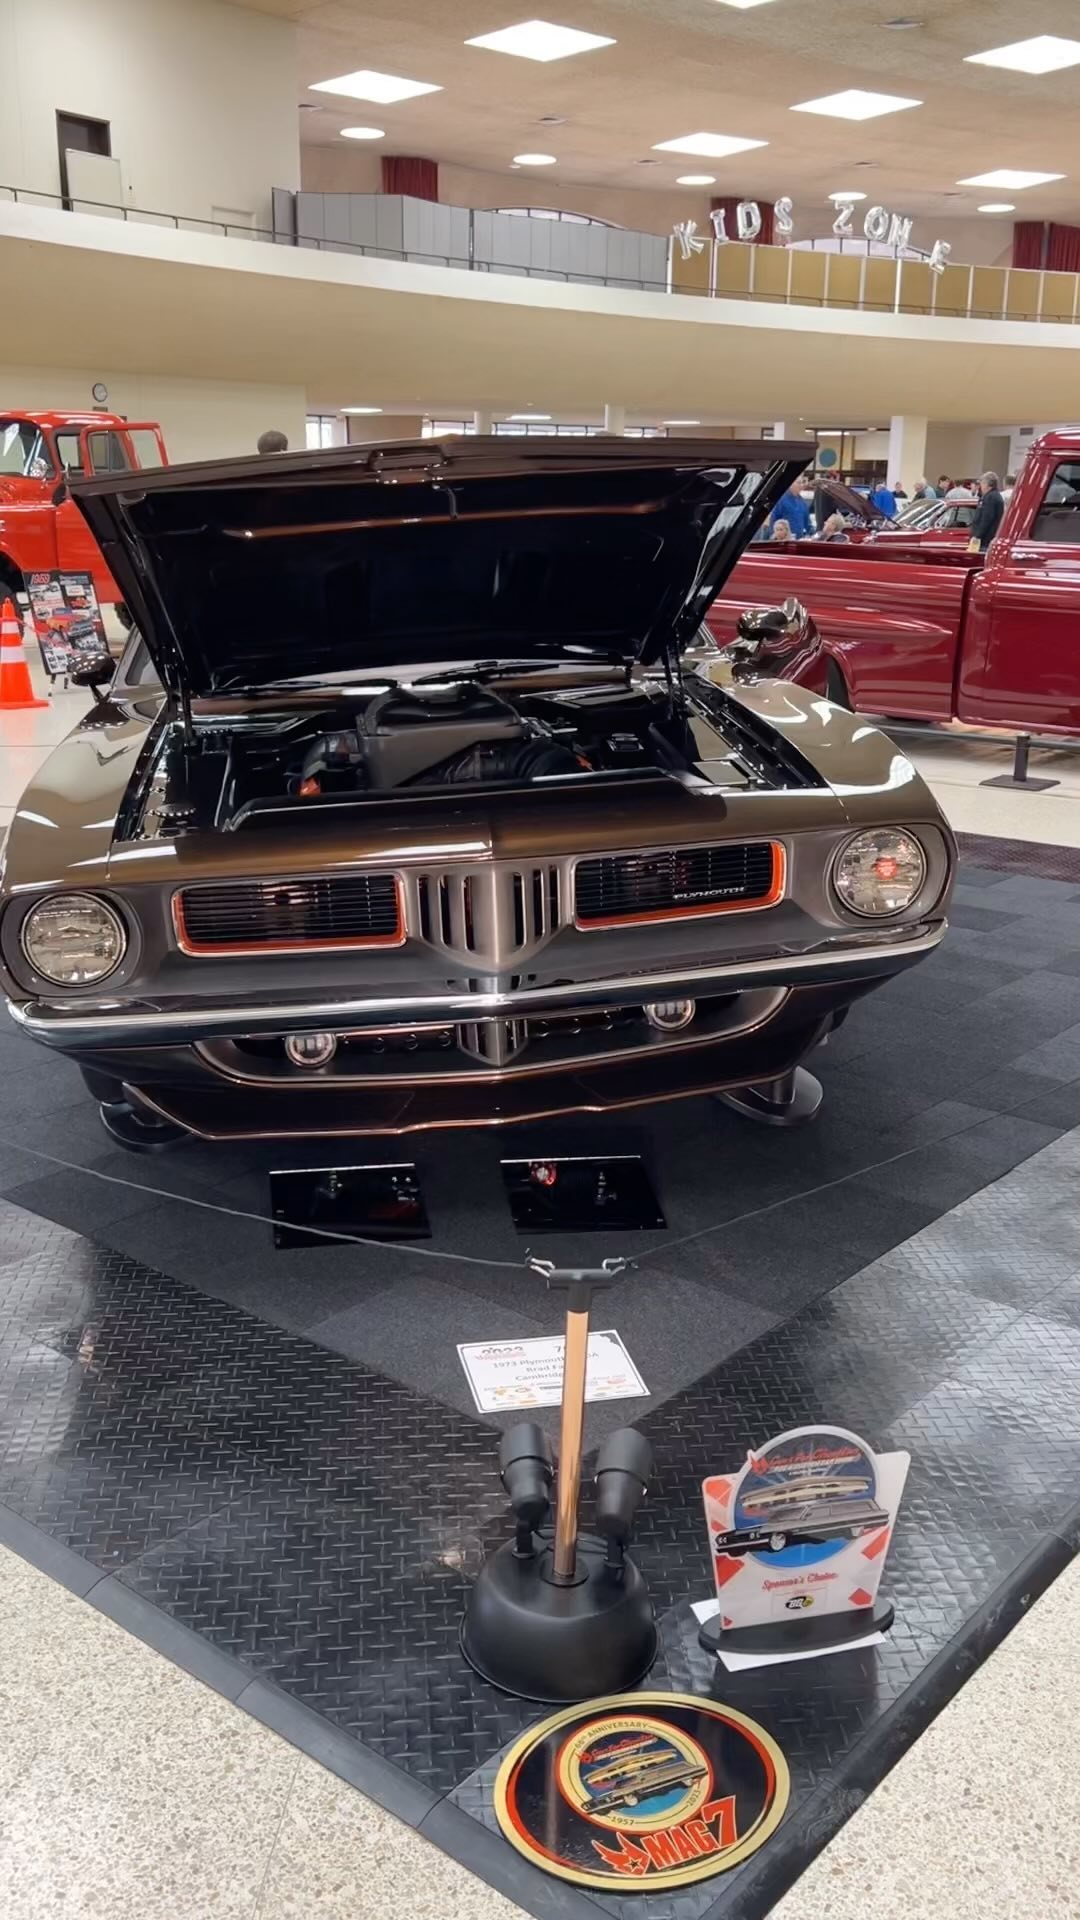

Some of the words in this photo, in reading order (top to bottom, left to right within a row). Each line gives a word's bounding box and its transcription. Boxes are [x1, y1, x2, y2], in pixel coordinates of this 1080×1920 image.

[673, 197, 794, 260] KIDS
[832, 200, 951, 274] ZONE
[673, 887, 744, 900] PLYMOUTH
[588, 1721, 648, 1737] ANNIVERSARY
[611, 1815, 635, 1826] 1957
